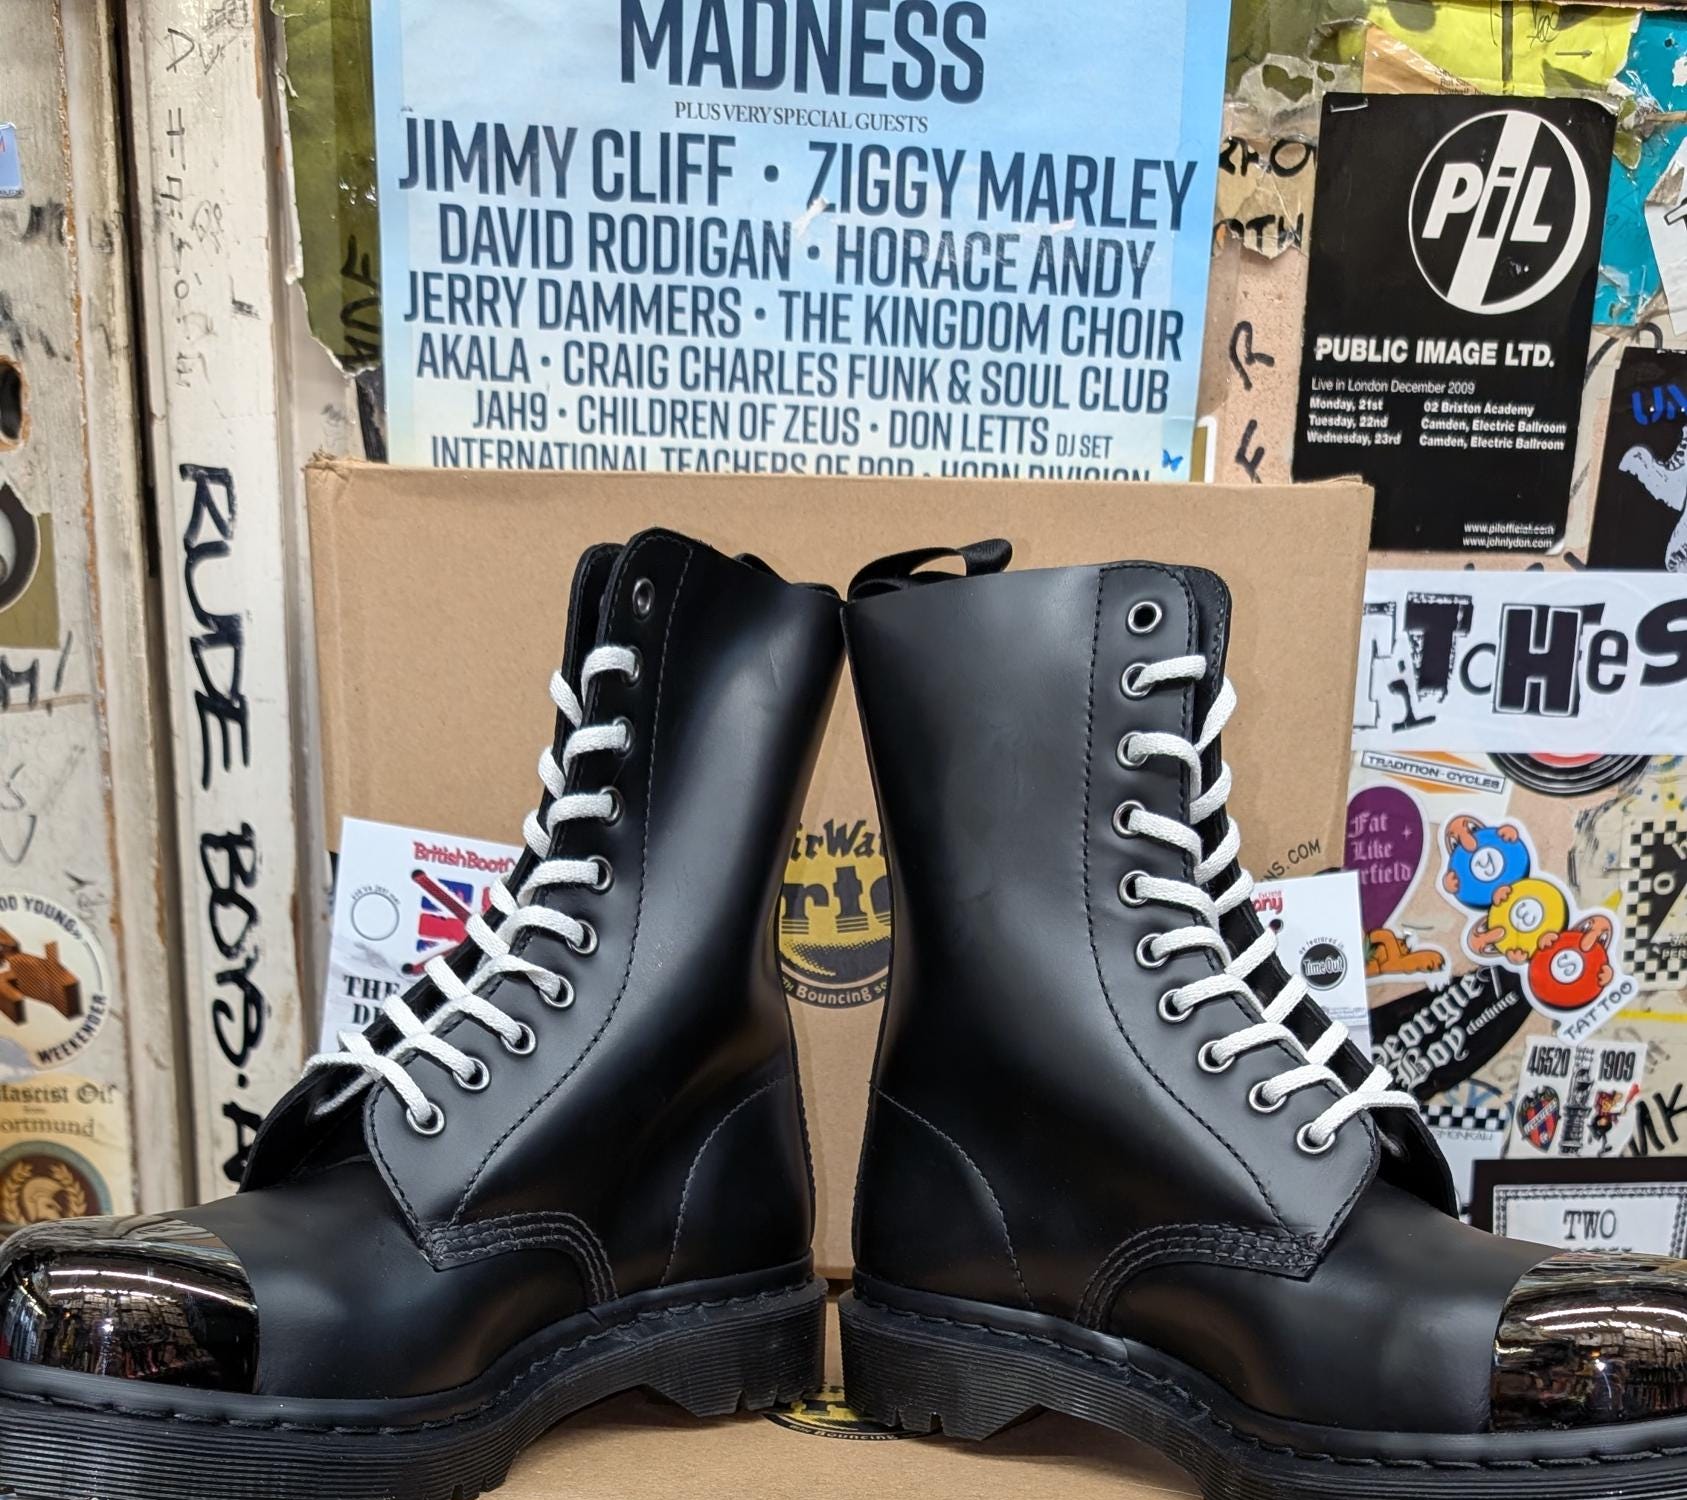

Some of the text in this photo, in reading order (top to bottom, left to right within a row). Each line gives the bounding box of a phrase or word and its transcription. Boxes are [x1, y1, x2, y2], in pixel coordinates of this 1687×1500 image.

[621, 0, 987, 105] MADNESS
[674, 101, 929, 133] PLUS VERY SPECIAL GUESTS
[398, 117, 578, 199] JIMMY
[591, 128, 737, 207] CLIFF
[806, 140, 967, 220] ZIGGY
[976, 149, 1198, 232] MARLEY
[439, 203, 574, 269] DAVID
[588, 211, 792, 281] RODIGAN
[834, 225, 1021, 293] HORACE
[1027, 231, 1156, 300] ANDY
[403, 270, 528, 329] JERRY
[537, 278, 742, 338] DAMMERS
[778, 289, 852, 345] THE
[863, 294, 1051, 355] KINGDOM
[1060, 304, 1184, 362] CHOIR
[1314, 337, 1556, 368] PUBLIC IMAGE LTD.
[416, 332, 1170, 415] AKALA CRAIG CHARLES FUNK & SOUL CLUB
[1311, 377, 1476, 394] Live in London December 2009
[472, 389, 1114, 460] JAH9 CHILDREN OF ZEUS DON LETTS DJ SET
[1308, 414, 1567, 434] Tuesday, 22nd Camden, Electric Ballroom
[1309, 398, 1357, 411] Monday,
[1358, 398, 1384, 411] 21st
[1441, 402, 1482, 414] Brixton
[1483, 403, 1536, 417] Academy
[432, 435, 648, 471] INTERNATIONAL
[660, 446, 807, 474] TEACHERS
[1306, 431, 1565, 451] Wednesday, 23rd Camden, Electric Ballroom
[1367, 755, 1500, 789] TRADITION CYCLES
[1348, 812, 1389, 839] Fat
[1352, 841, 1393, 862] Like
[343, 974, 400, 1000] THE
[796, 984, 872, 1005] Bouncing
[1563, 981, 1633, 1041] TATTOO
[36, 992, 107, 1065] WEEKENDER
[1388, 1025, 1470, 1094] Boy
[1526, 1045, 1637, 1082] 46520 1909
[1563, 1209, 1618, 1241] TWO
